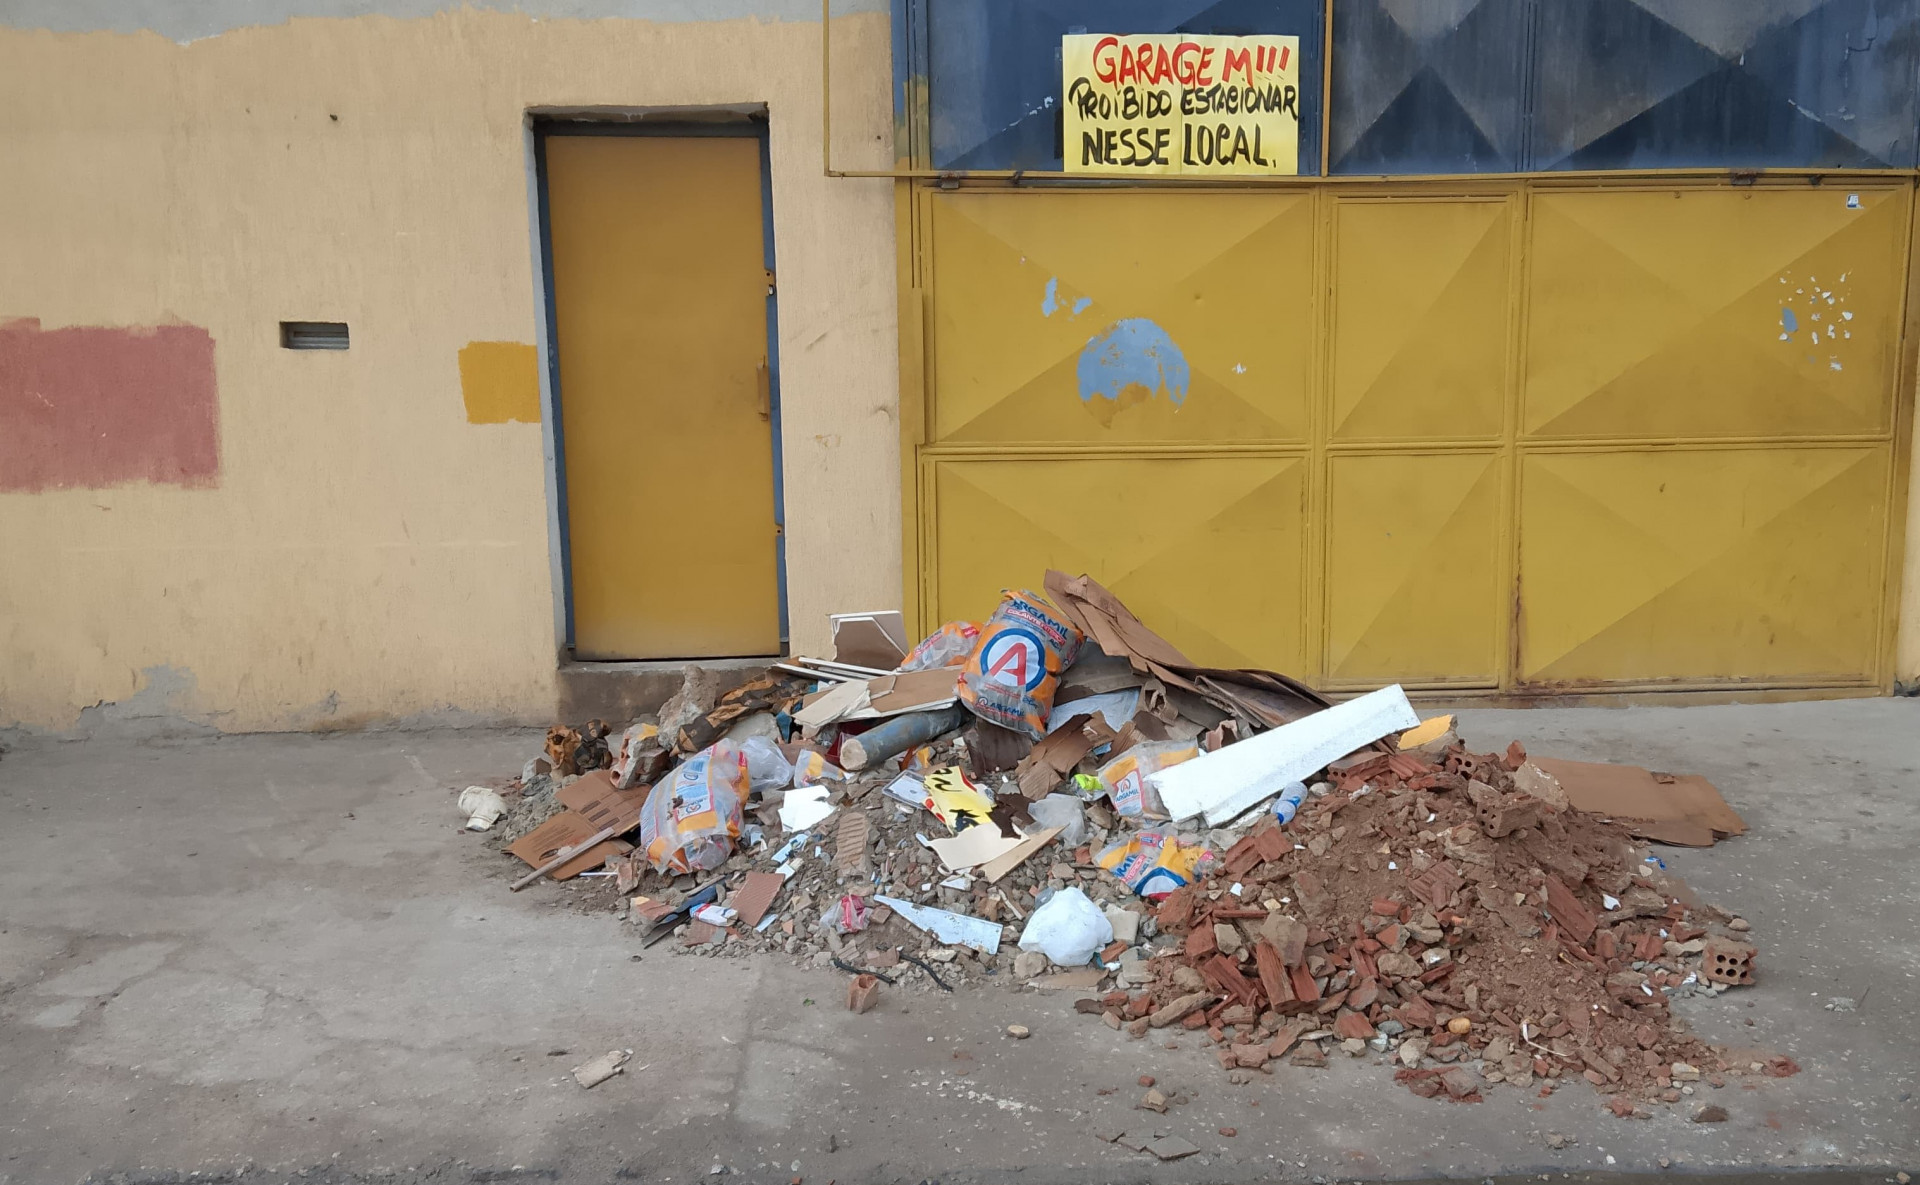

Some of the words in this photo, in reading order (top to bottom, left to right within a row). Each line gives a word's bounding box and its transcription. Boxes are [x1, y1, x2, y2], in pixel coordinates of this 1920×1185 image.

[1181, 82, 1299, 122] ESTACIONAR
[1081, 127, 1171, 166] NESSE
[1010, 600, 1069, 640] ARGAMIL
